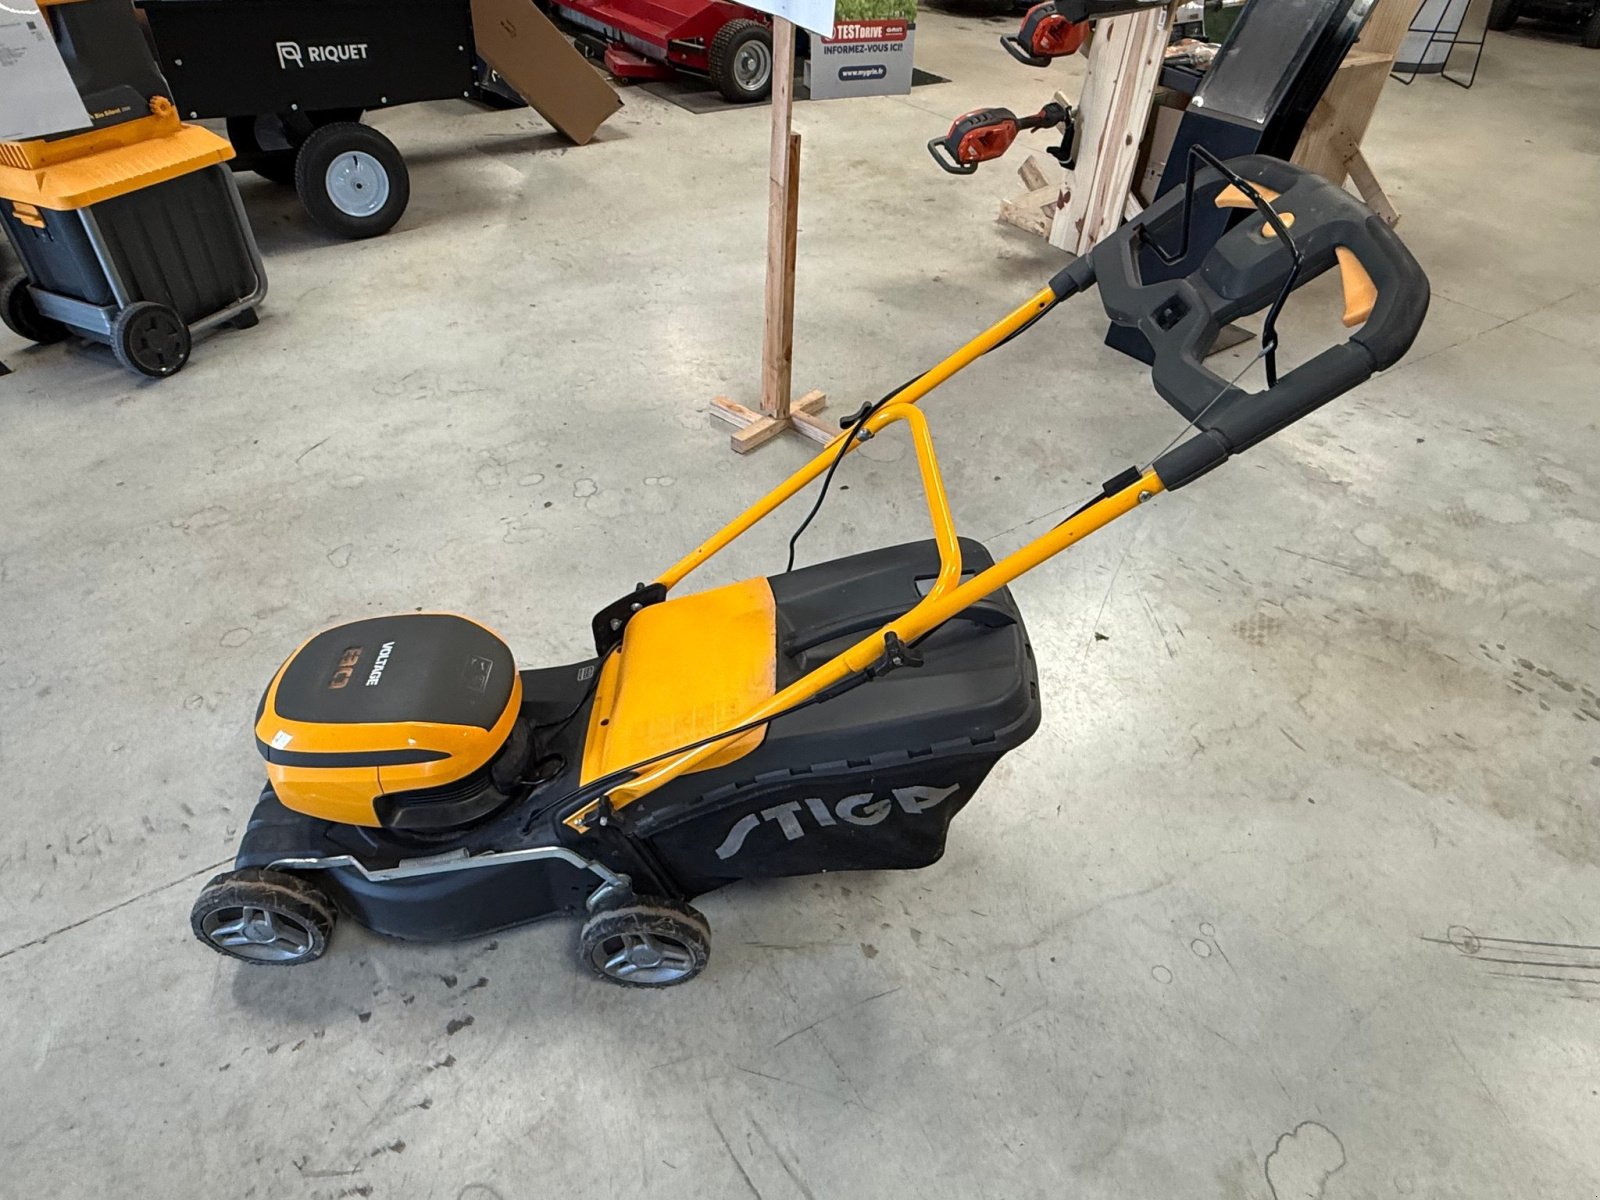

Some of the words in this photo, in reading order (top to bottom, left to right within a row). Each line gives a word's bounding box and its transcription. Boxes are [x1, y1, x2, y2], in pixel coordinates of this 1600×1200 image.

[308, 44, 368, 62] RIQUET
[824, 44, 889, 55] INFORMEZ-VOUS
[365, 641, 396, 687] VOLTAGE
[715, 782, 960, 860] STIGA
